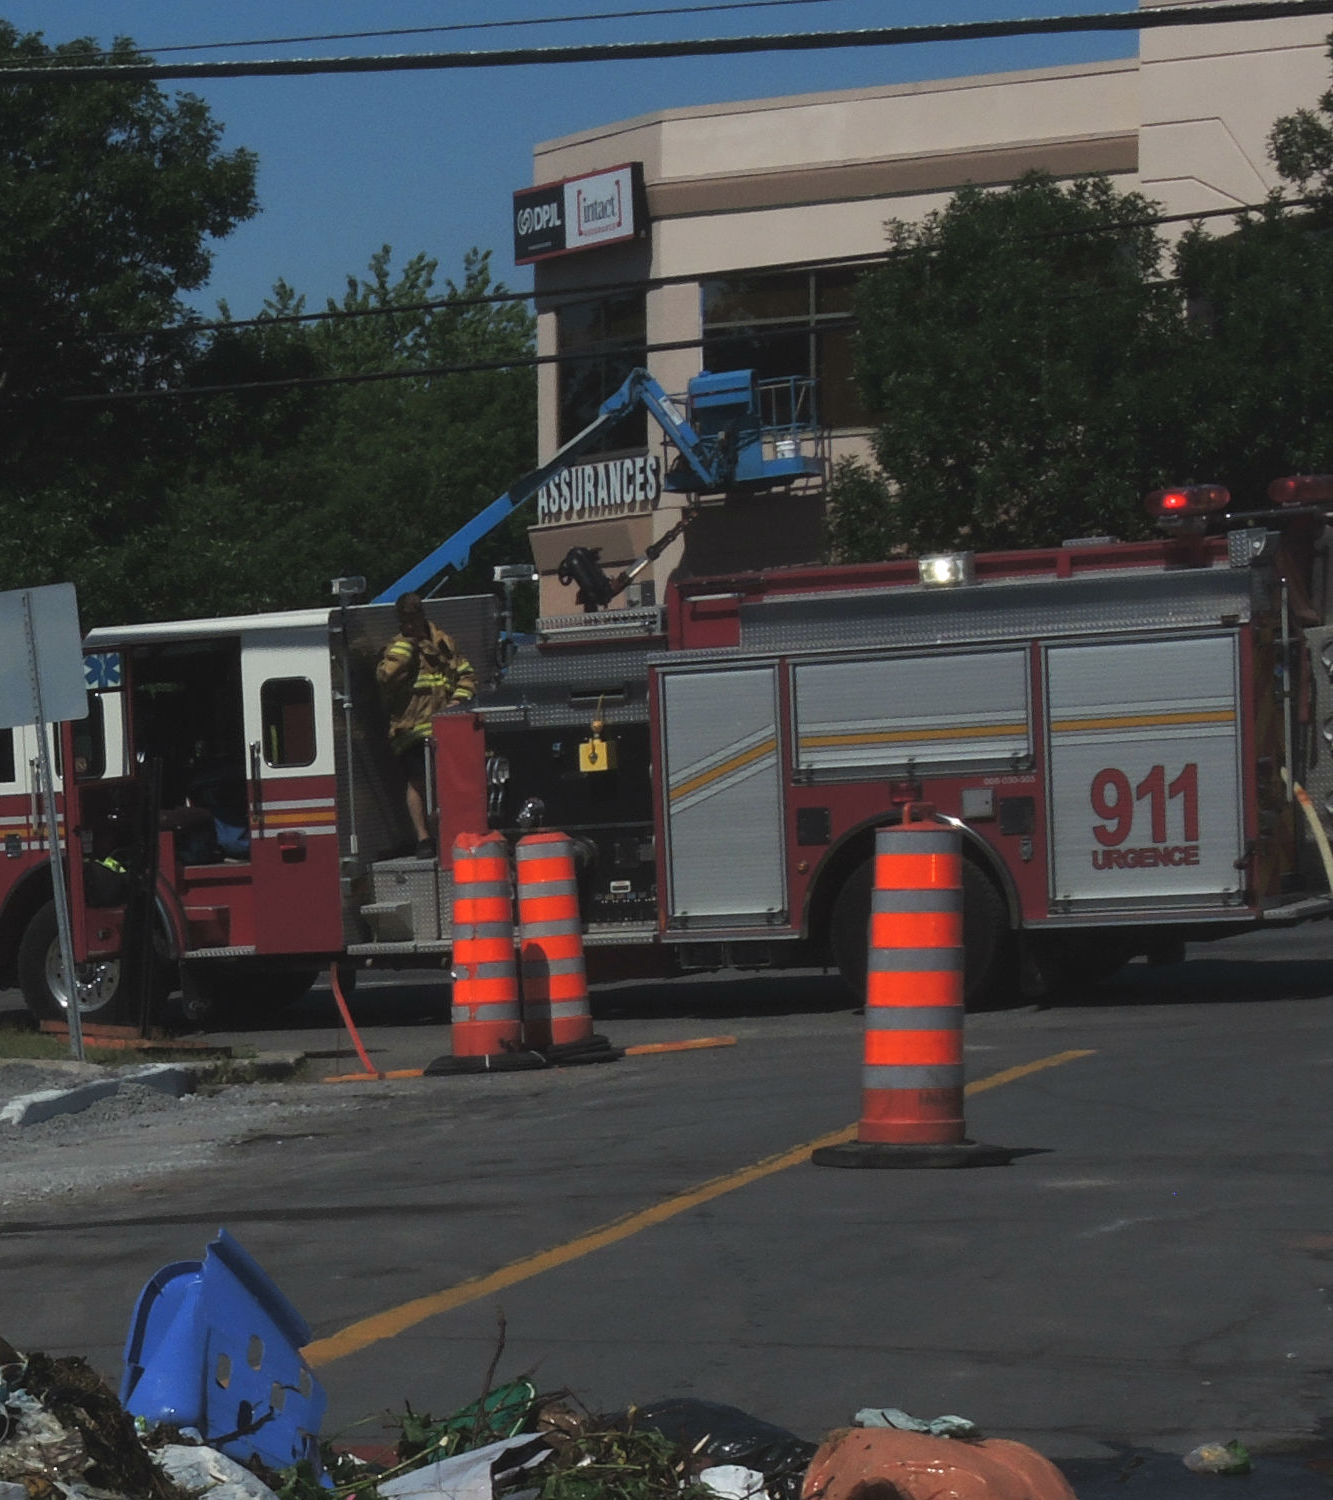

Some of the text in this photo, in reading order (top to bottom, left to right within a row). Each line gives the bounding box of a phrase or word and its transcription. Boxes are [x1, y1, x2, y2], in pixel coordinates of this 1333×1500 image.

[534, 202, 562, 232] DPJL
[583, 196, 617, 223] intact
[537, 457, 657, 514] ASSURANCES
[1091, 763, 1199, 847] 911
[1092, 846, 1200, 870] URGENCE
